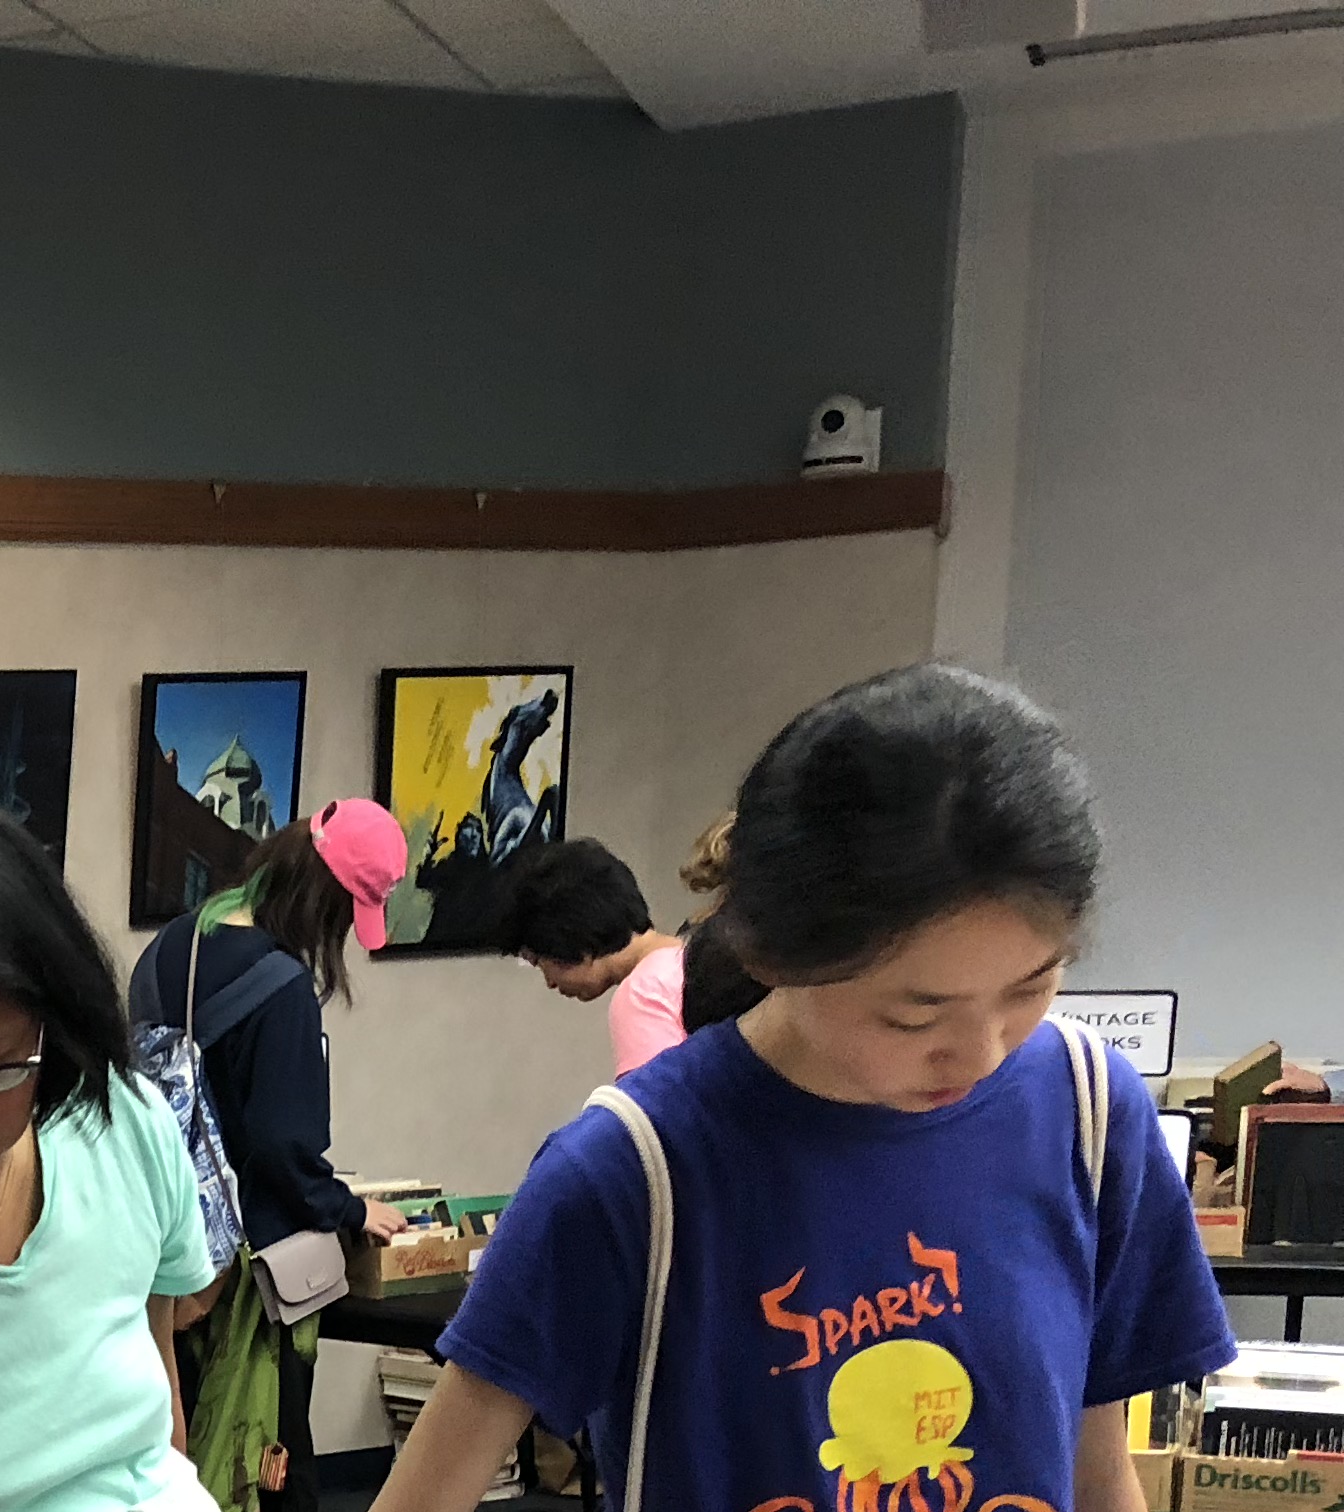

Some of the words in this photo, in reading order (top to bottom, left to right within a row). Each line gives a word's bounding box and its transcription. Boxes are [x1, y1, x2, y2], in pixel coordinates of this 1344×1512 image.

[1062, 1011, 1157, 1028] NTAGE
[913, 1386, 962, 1414] MIT
[914, 1414, 959, 1446] ESP
